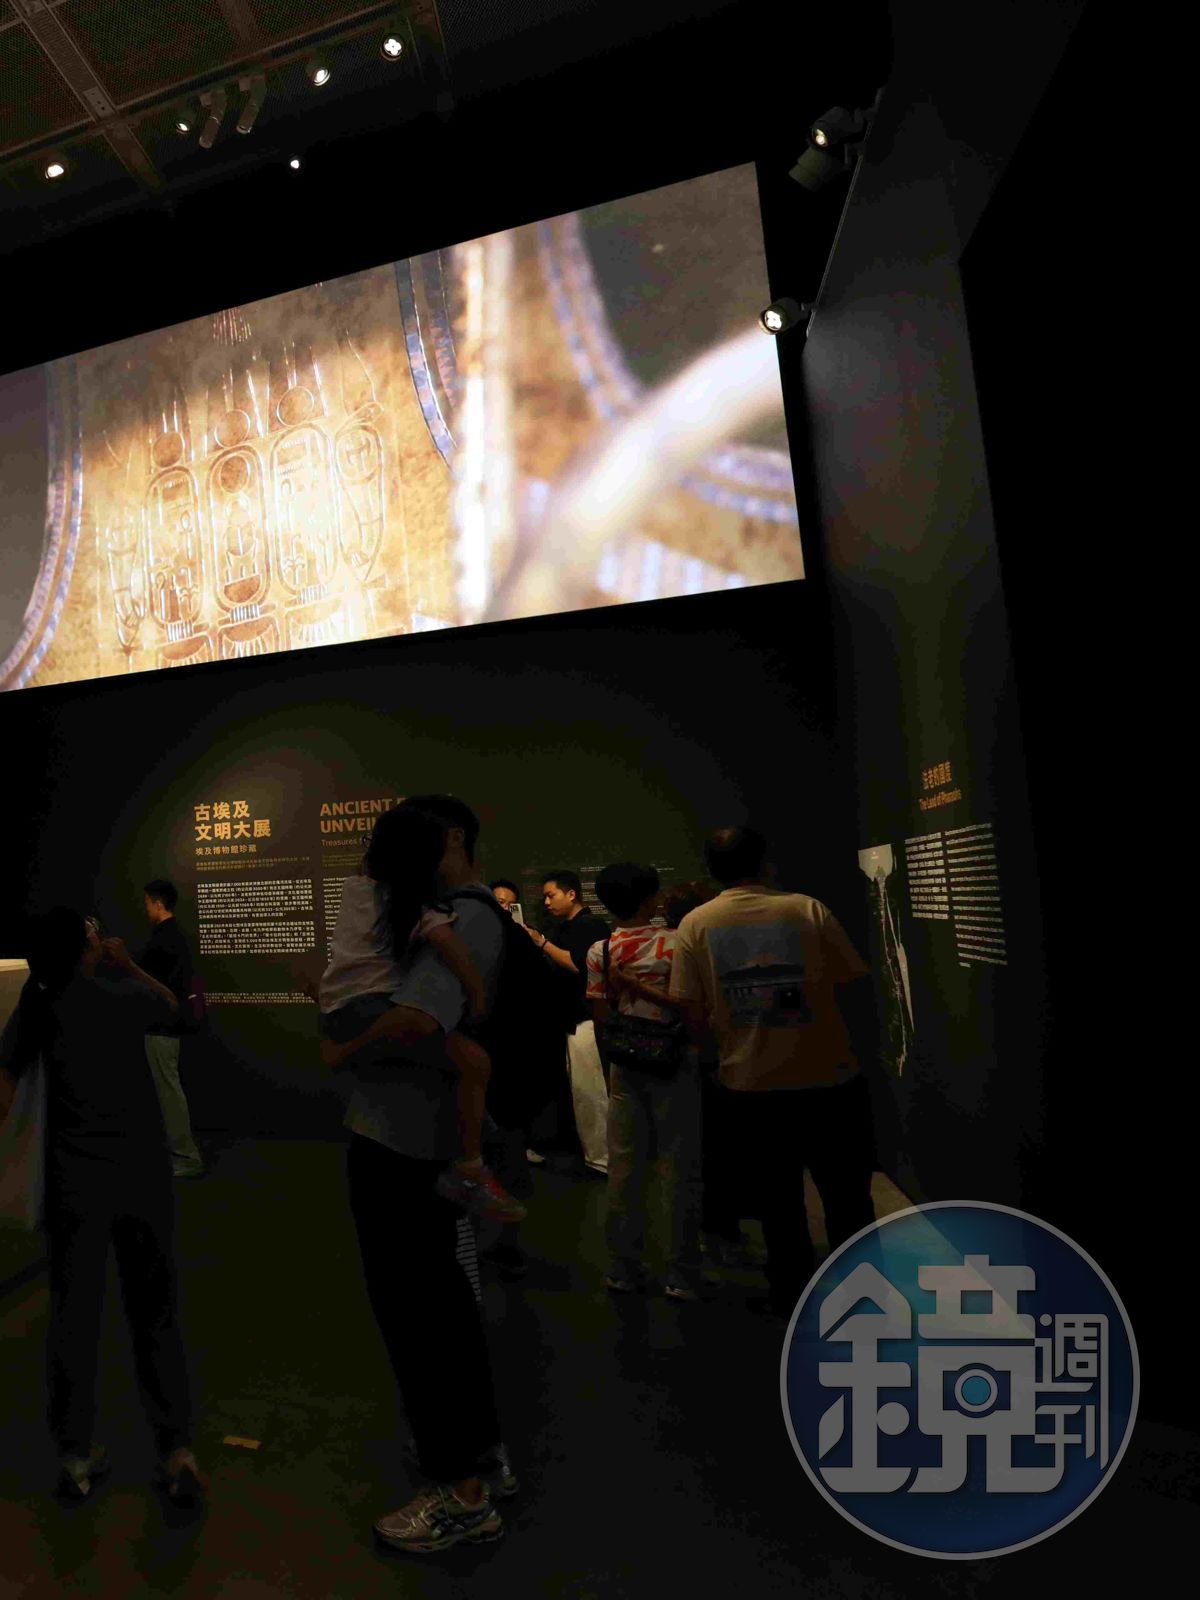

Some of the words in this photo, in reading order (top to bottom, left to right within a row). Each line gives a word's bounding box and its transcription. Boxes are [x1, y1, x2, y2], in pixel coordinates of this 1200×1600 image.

[193, 800, 251, 822] 古埃及
[320, 798, 393, 817] ANCIENT
[194, 819, 272, 842] 文明大展
[195, 844, 257, 856] 埃及博物館珍藏
[321, 838, 358, 848] Treasures
